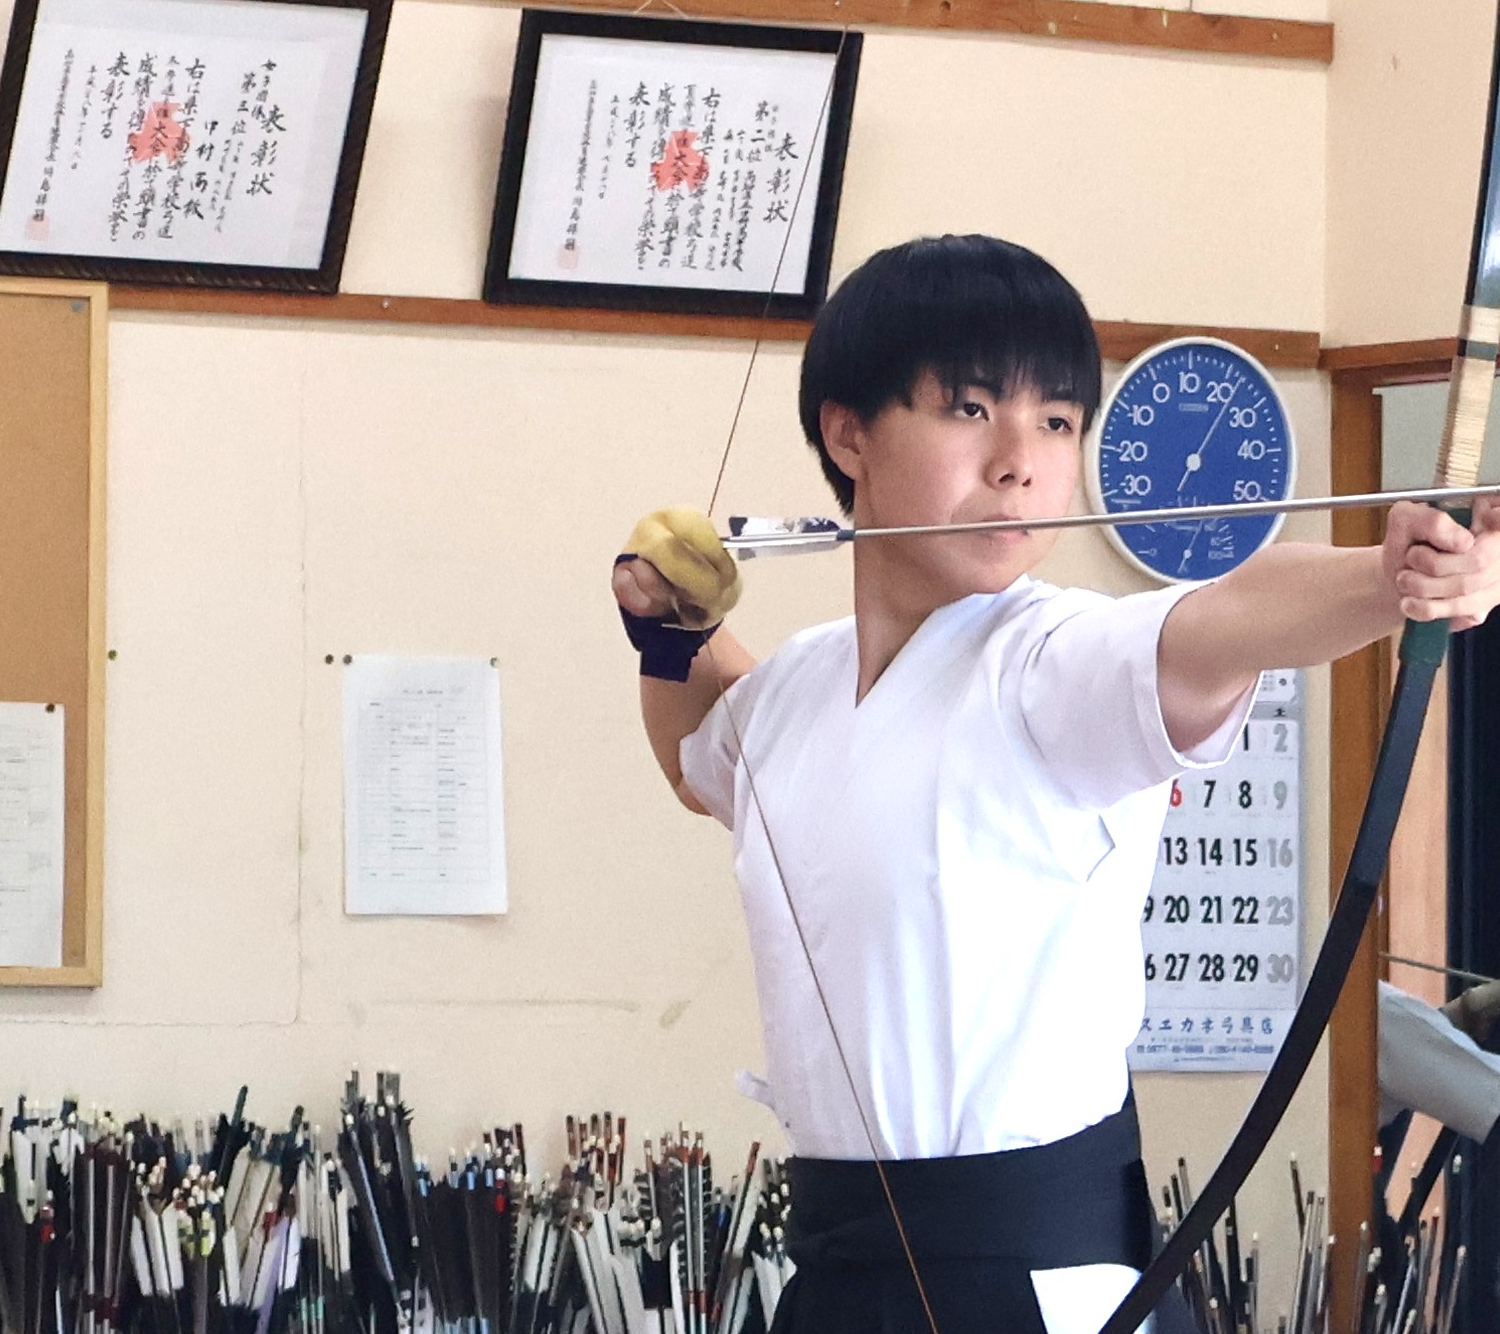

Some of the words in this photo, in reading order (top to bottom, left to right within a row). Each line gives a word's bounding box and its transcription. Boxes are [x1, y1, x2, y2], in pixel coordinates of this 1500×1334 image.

[246, 104, 287, 197] 表彰状
[763, 131, 800, 224] 表彰状
[1152, 382, 1170, 404] 0
[1178, 371, 1200, 394] 10
[1206, 381, 1235, 403] 20
[1229, 407, 1256, 428] 30
[1237, 439, 1266, 461] 40
[1233, 480, 1261, 501] 50
[1243, 723, 1249, 751] 1
[1273, 723, 1288, 752] 2
[1203, 779, 1217, 808] 7
[1238, 780, 1252, 809] 8
[1273, 780, 1288, 810] 9
[1163, 836, 1188, 866] 13
[1198, 837, 1223, 866] 14
[1233, 838, 1258, 867] 15
[1268, 838, 1293, 868] 16
[1143, 895, 1155, 923] 9
[1164, 895, 1190, 923] 20
[1200, 895, 1223, 924] 21
[1232, 895, 1259, 924] 22
[1266, 895, 1293, 926] 23
[1144, 953, 1156, 981] 6
[1165, 953, 1190, 981] 27
[1198, 953, 1225, 982] 28
[1233, 954, 1259, 982] 29
[1267, 953, 1294, 983] 30
